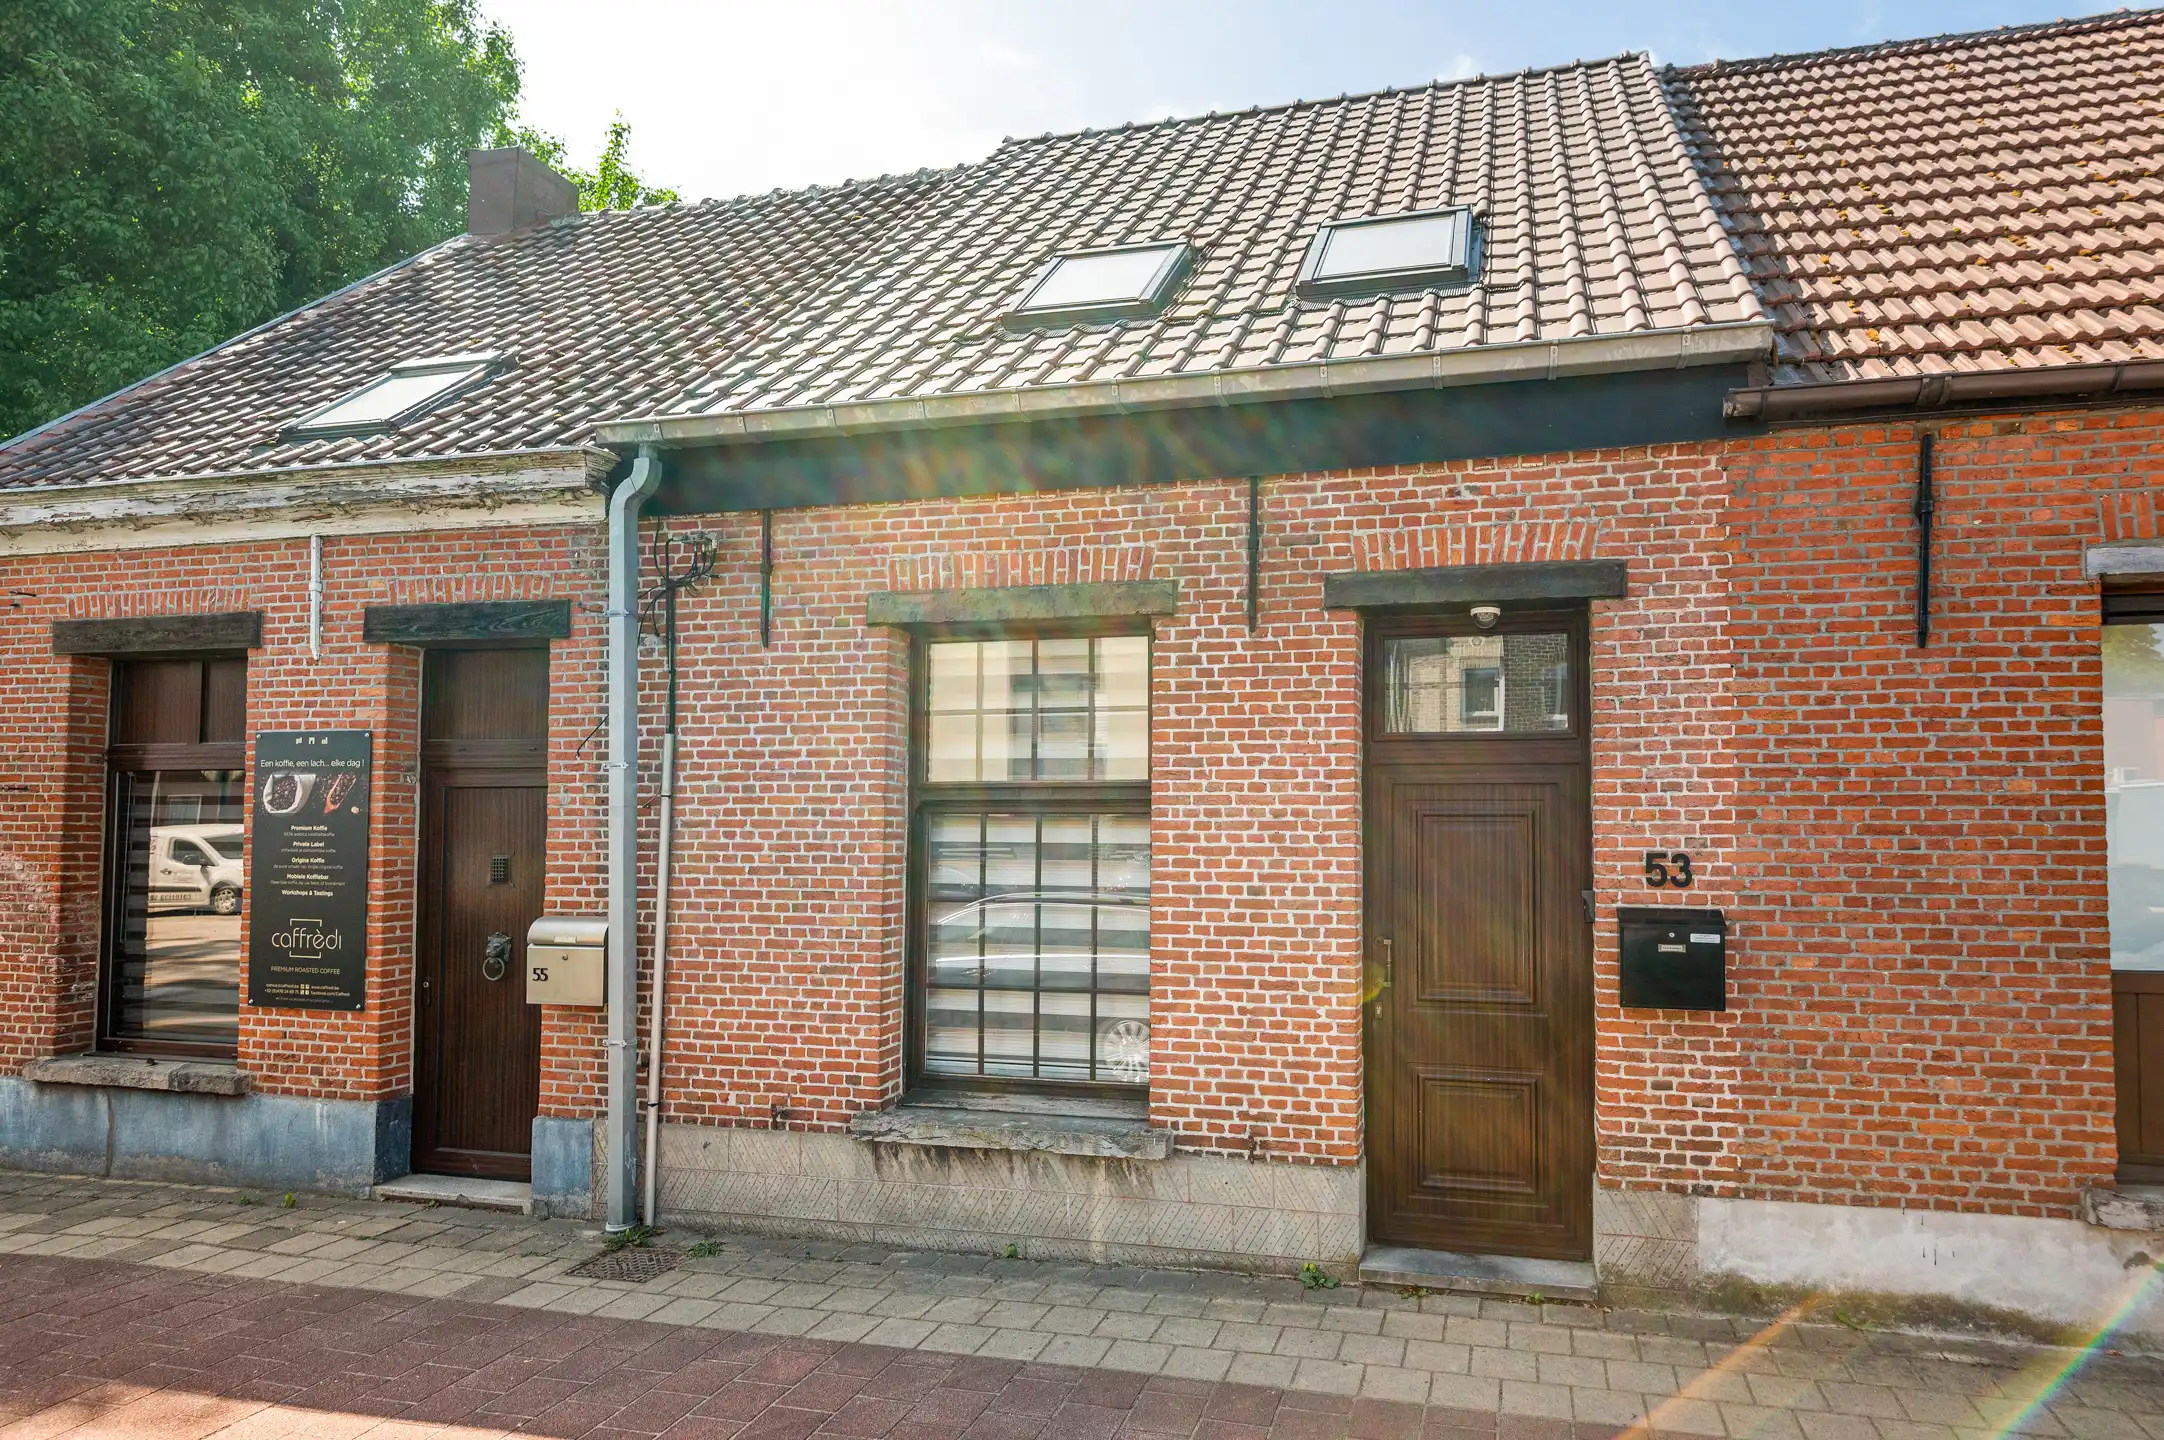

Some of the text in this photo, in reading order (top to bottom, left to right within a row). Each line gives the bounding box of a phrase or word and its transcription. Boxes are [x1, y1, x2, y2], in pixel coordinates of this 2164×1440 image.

[260, 760, 274, 768] Een
[274, 760, 295, 768] koffie,
[310, 759, 330, 767] lach...
[330, 759, 345, 767] elke
[346, 759, 360, 768] dag
[1646, 852, 1692, 888] 53
[532, 968, 548, 982] 55
